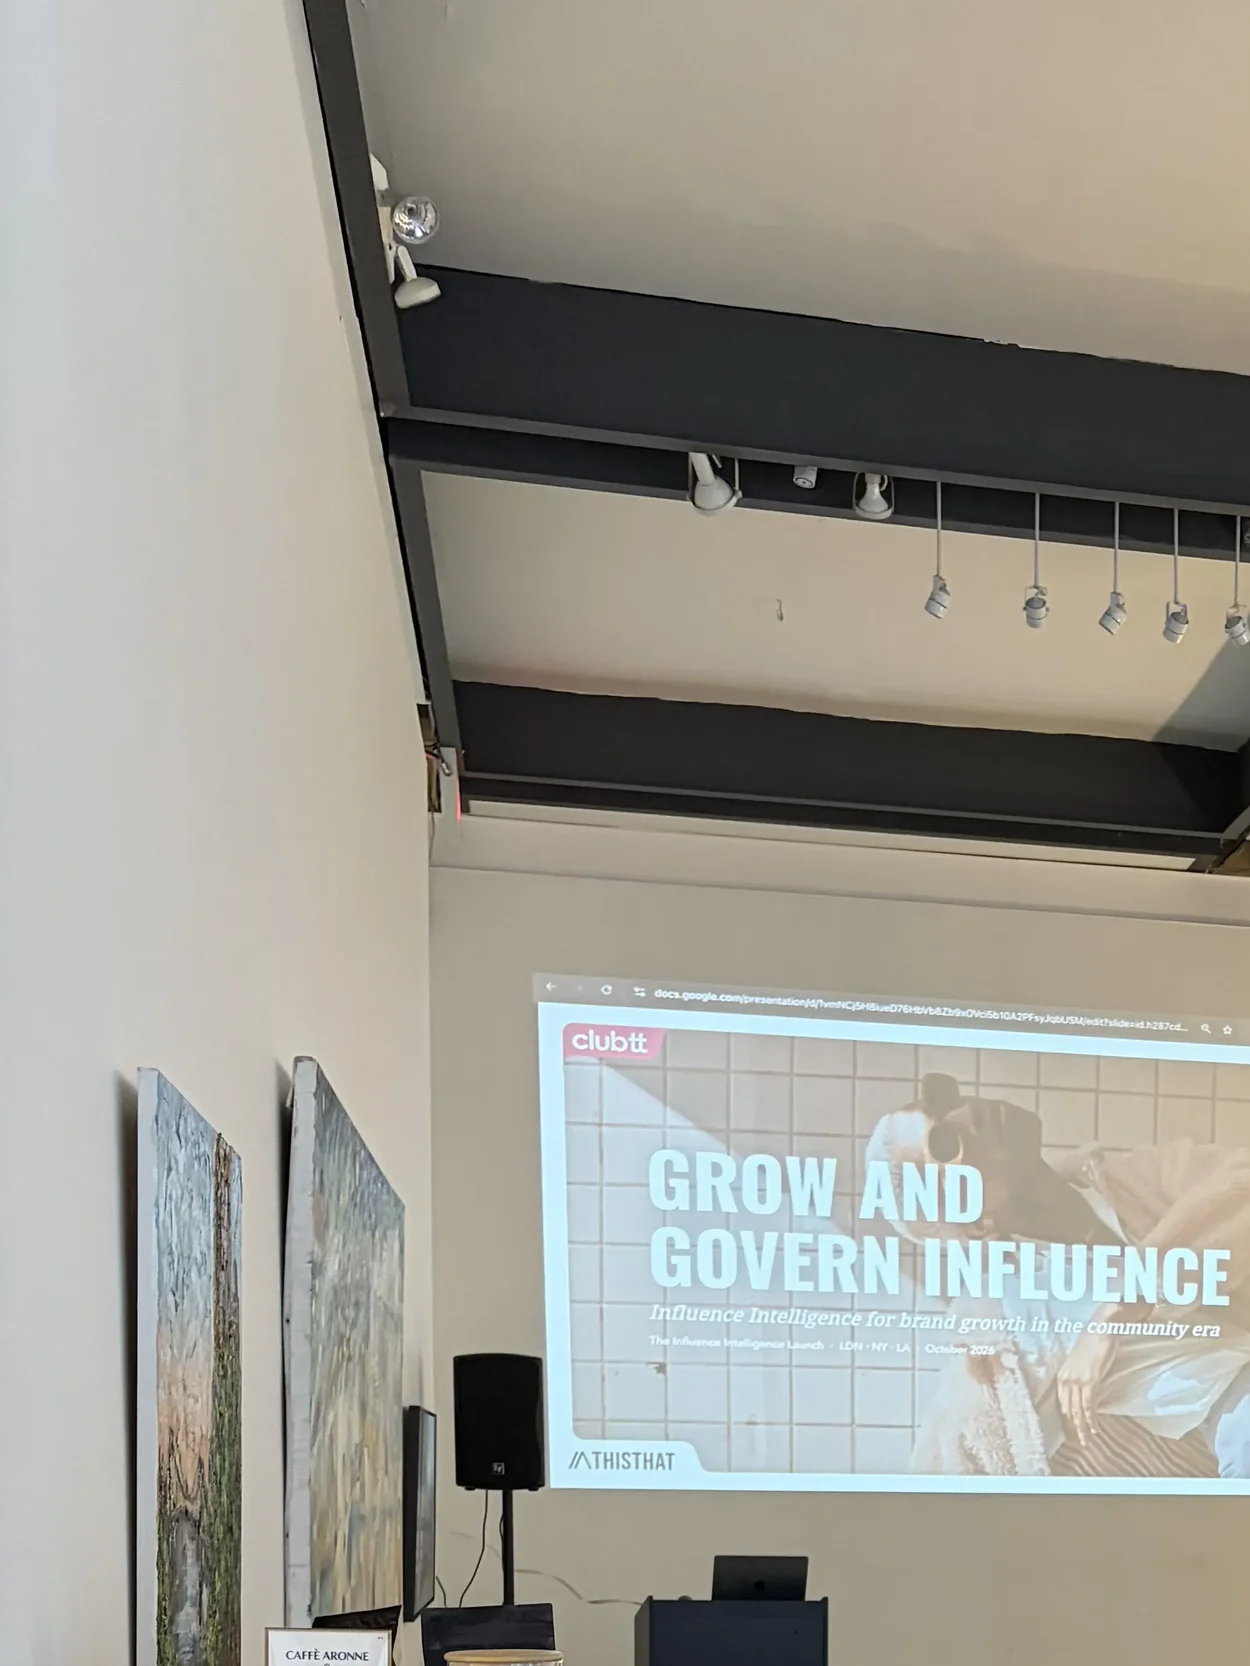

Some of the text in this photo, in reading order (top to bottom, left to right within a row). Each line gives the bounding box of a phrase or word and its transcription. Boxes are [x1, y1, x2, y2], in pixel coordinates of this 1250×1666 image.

[572, 1029, 648, 1053] clubtt
[650, 1149, 984, 1223] GROW AND
[651, 1227, 1231, 1306] GOVERN INFLUENCE
[649, 1304, 1220, 1340] Influence Intelligence for brand growth in the community era
[649, 1335, 670, 1346] The
[672, 1336, 721, 1348] Influence
[723, 1338, 786, 1351] Intelligence
[787, 1340, 824, 1351] Launch
[839, 1341, 863, 1351] LDN
[871, 1342, 888, 1352] NY
[896, 1343, 912, 1353] LA
[925, 1344, 968, 1354] October
[285, 1648, 369, 1662] CAFFÈ ARONNE
